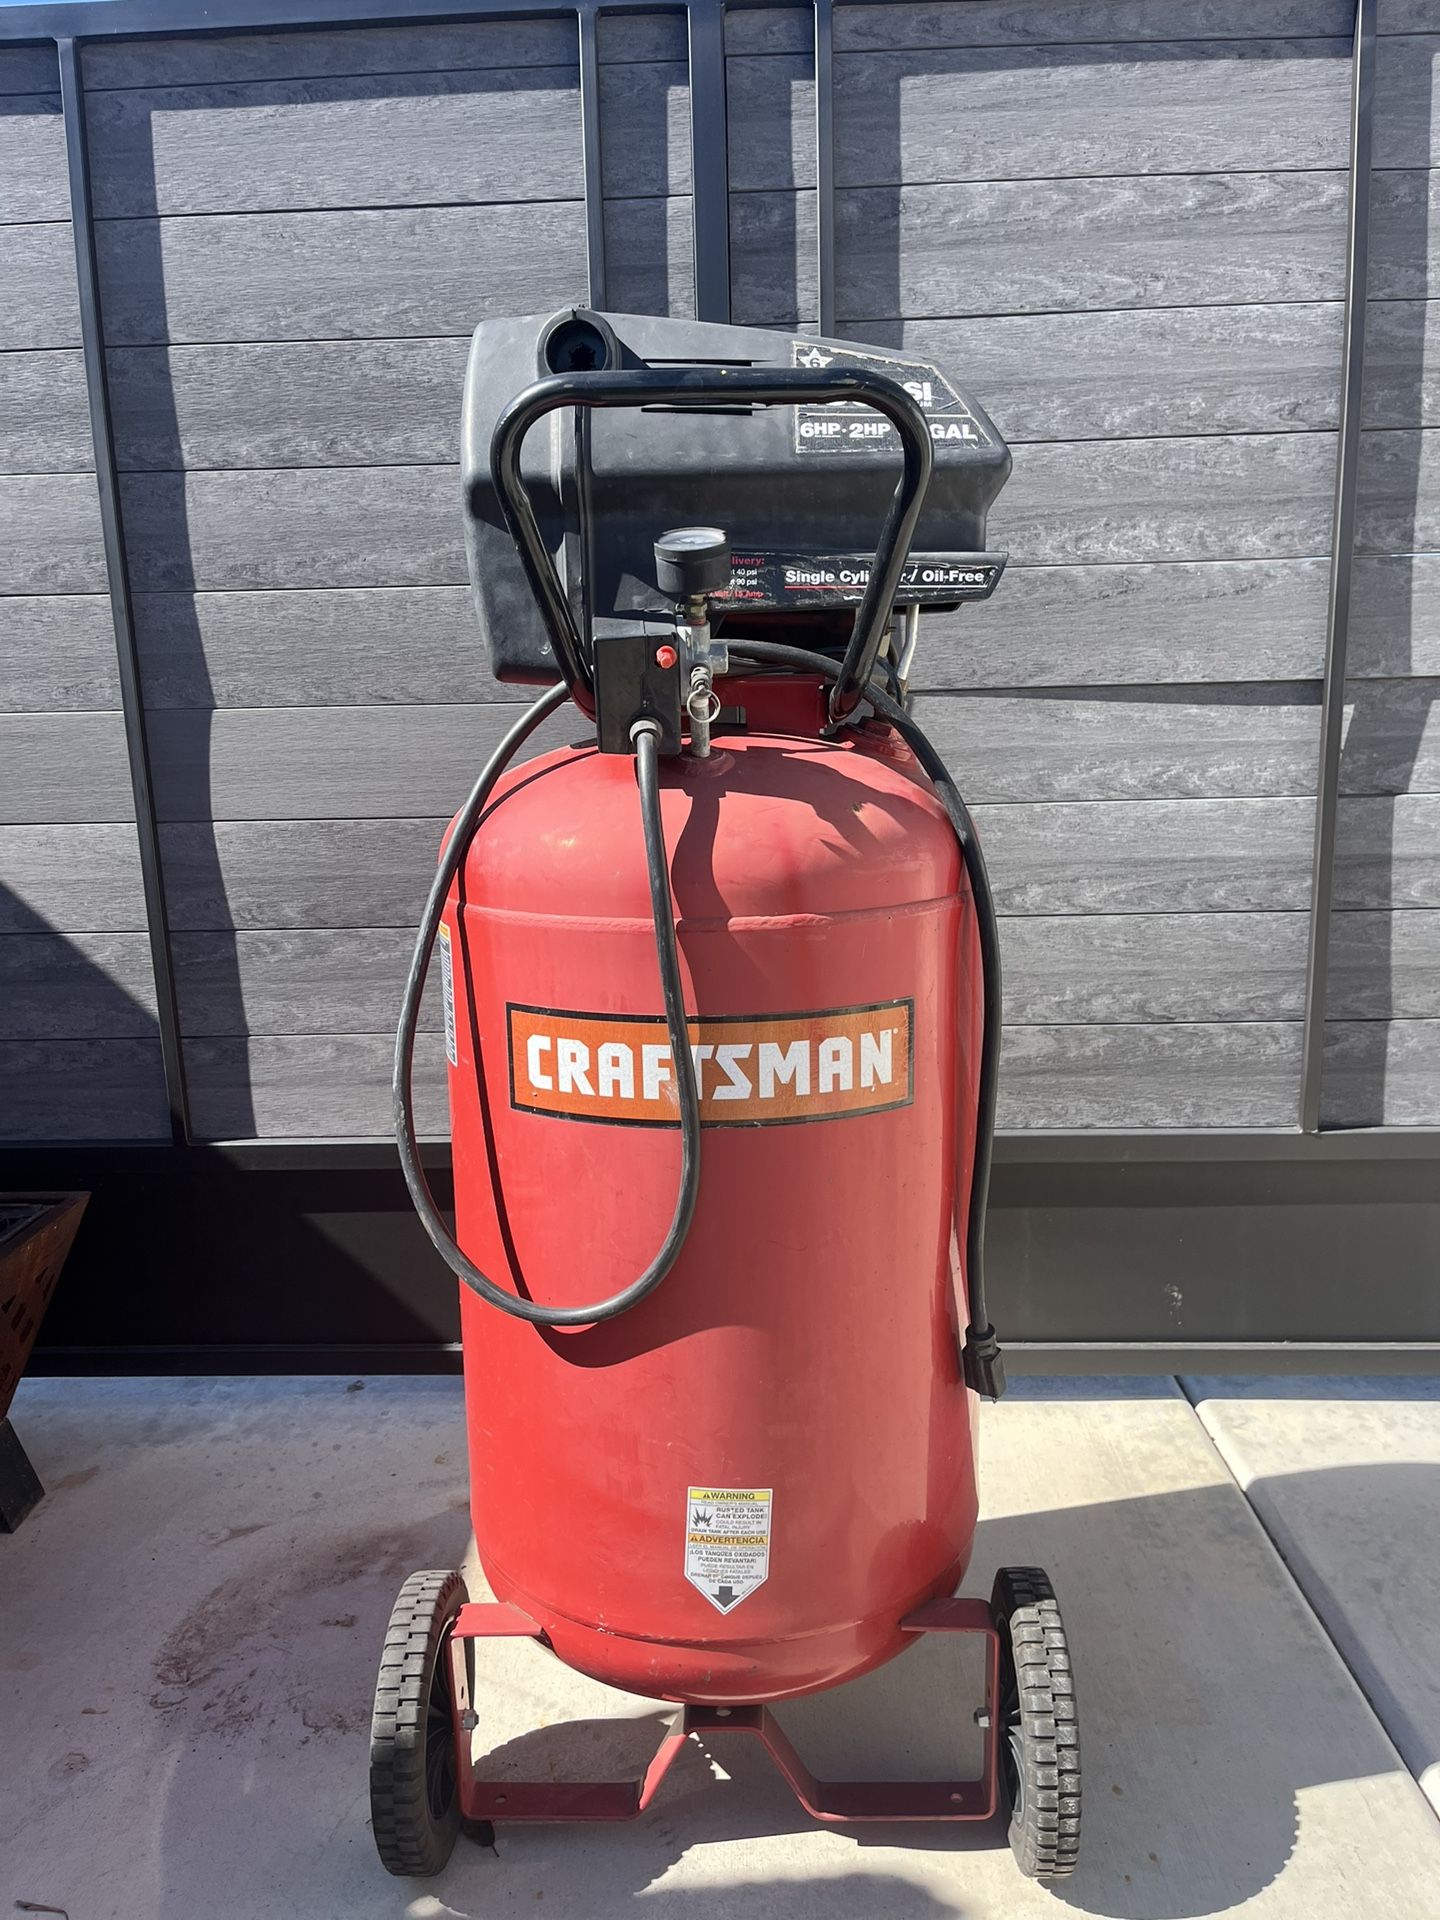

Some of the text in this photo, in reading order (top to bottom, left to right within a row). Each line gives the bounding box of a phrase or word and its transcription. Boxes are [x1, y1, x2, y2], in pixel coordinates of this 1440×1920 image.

[810, 357, 820, 367] 6
[903, 382, 931, 400] SI
[746, 568, 757, 576] psi
[785, 570, 835, 585] Single
[922, 569, 984, 583] Oil-Free
[746, 578, 757, 586] psi
[527, 1029, 893, 1100] CRAFTSMAN
[711, 1492, 755, 1500] WARNING
[699, 1535, 765, 1544] ADVERTENCIA
